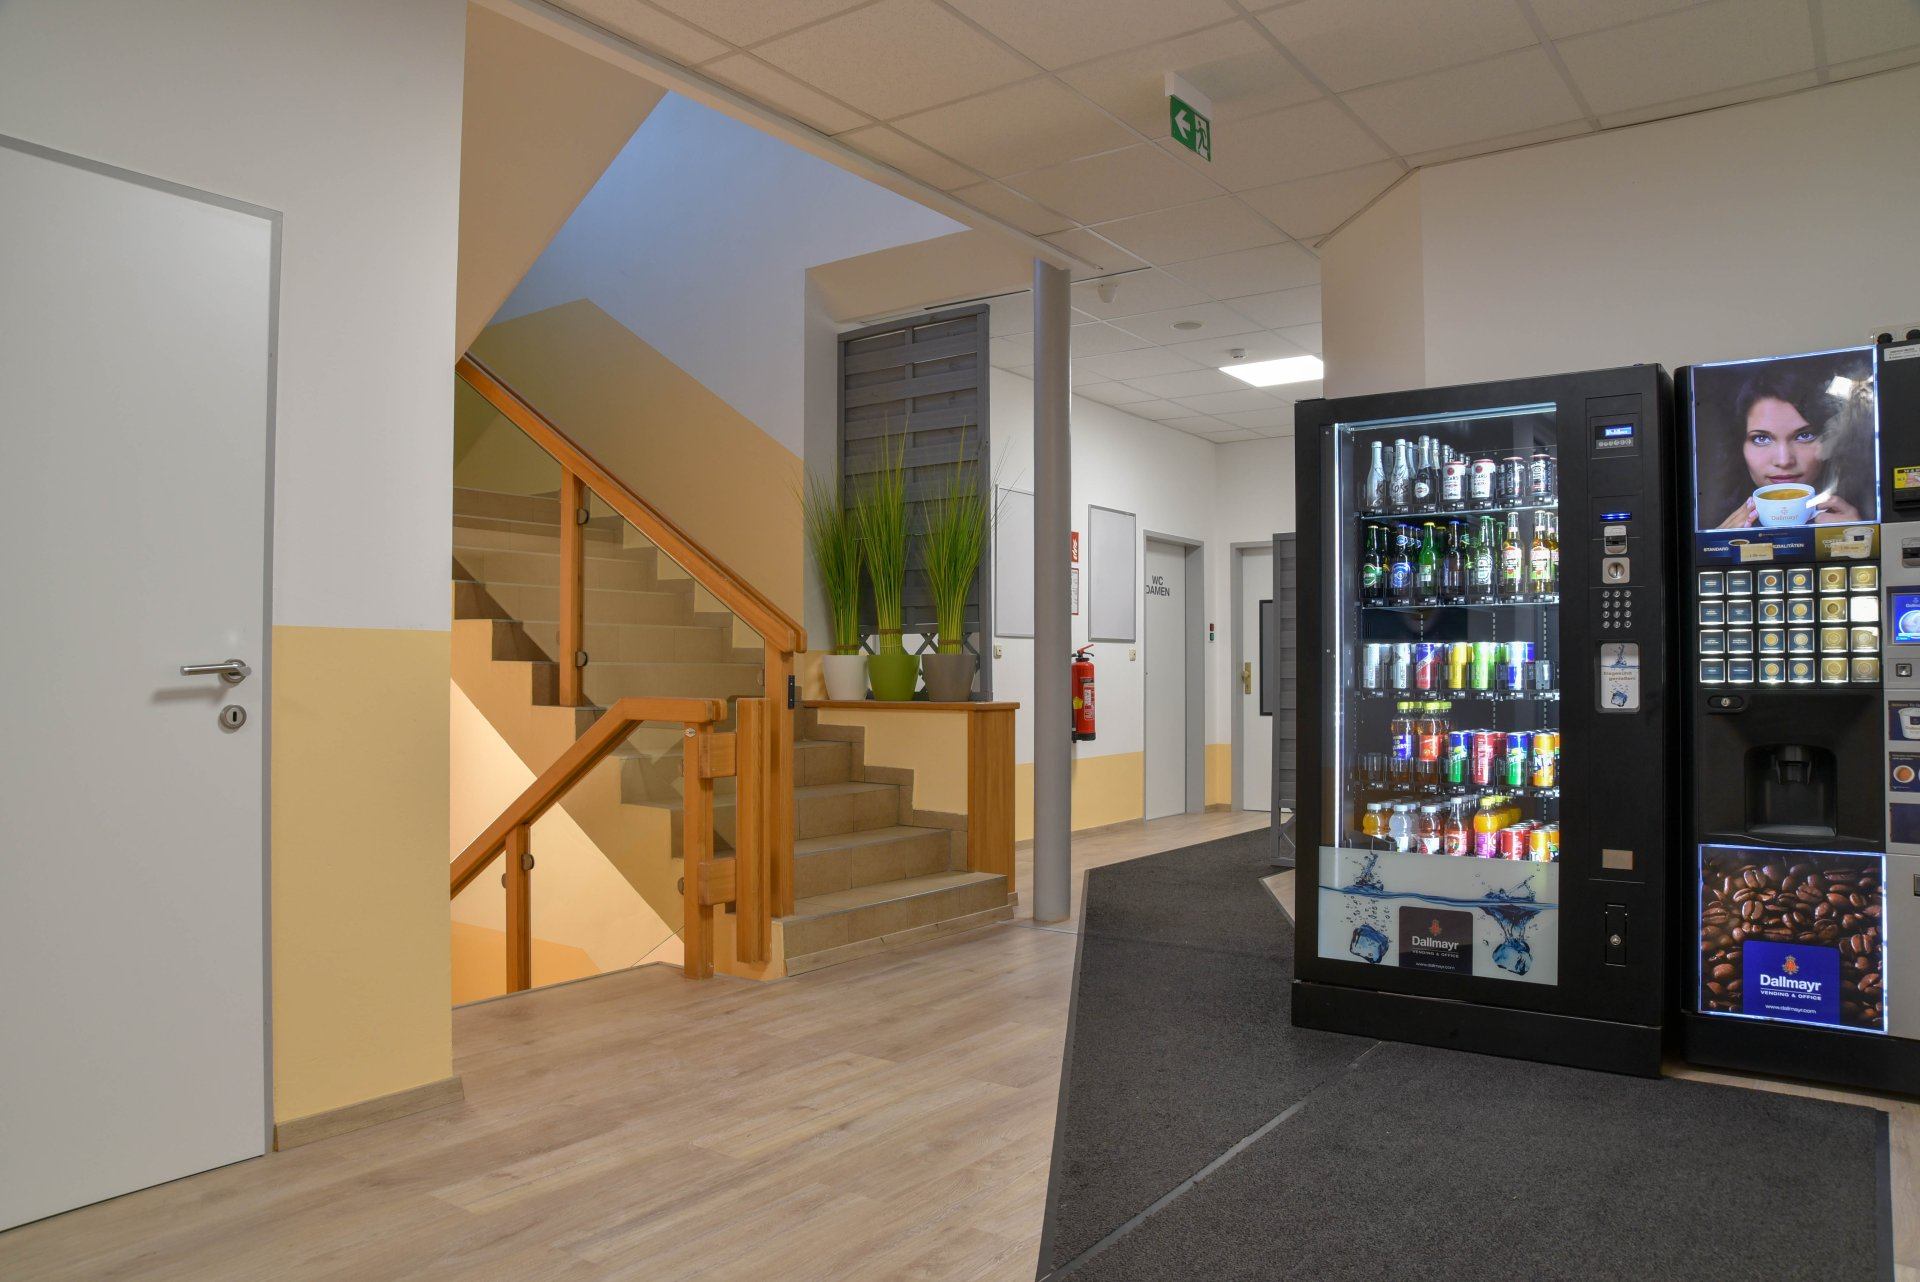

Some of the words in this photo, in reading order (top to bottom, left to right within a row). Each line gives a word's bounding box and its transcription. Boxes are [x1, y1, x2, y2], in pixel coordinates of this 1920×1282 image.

[1152, 575, 1164, 585] WC
[1145, 584, 1170, 596] DAMEN
[1412, 935, 1459, 951] Dallmayr
[1416, 962, 1456, 970] www.dallmayr.com
[1760, 974, 1822, 993] Dallmayr
[1765, 1004, 1817, 1014] www.dallmayr.com
